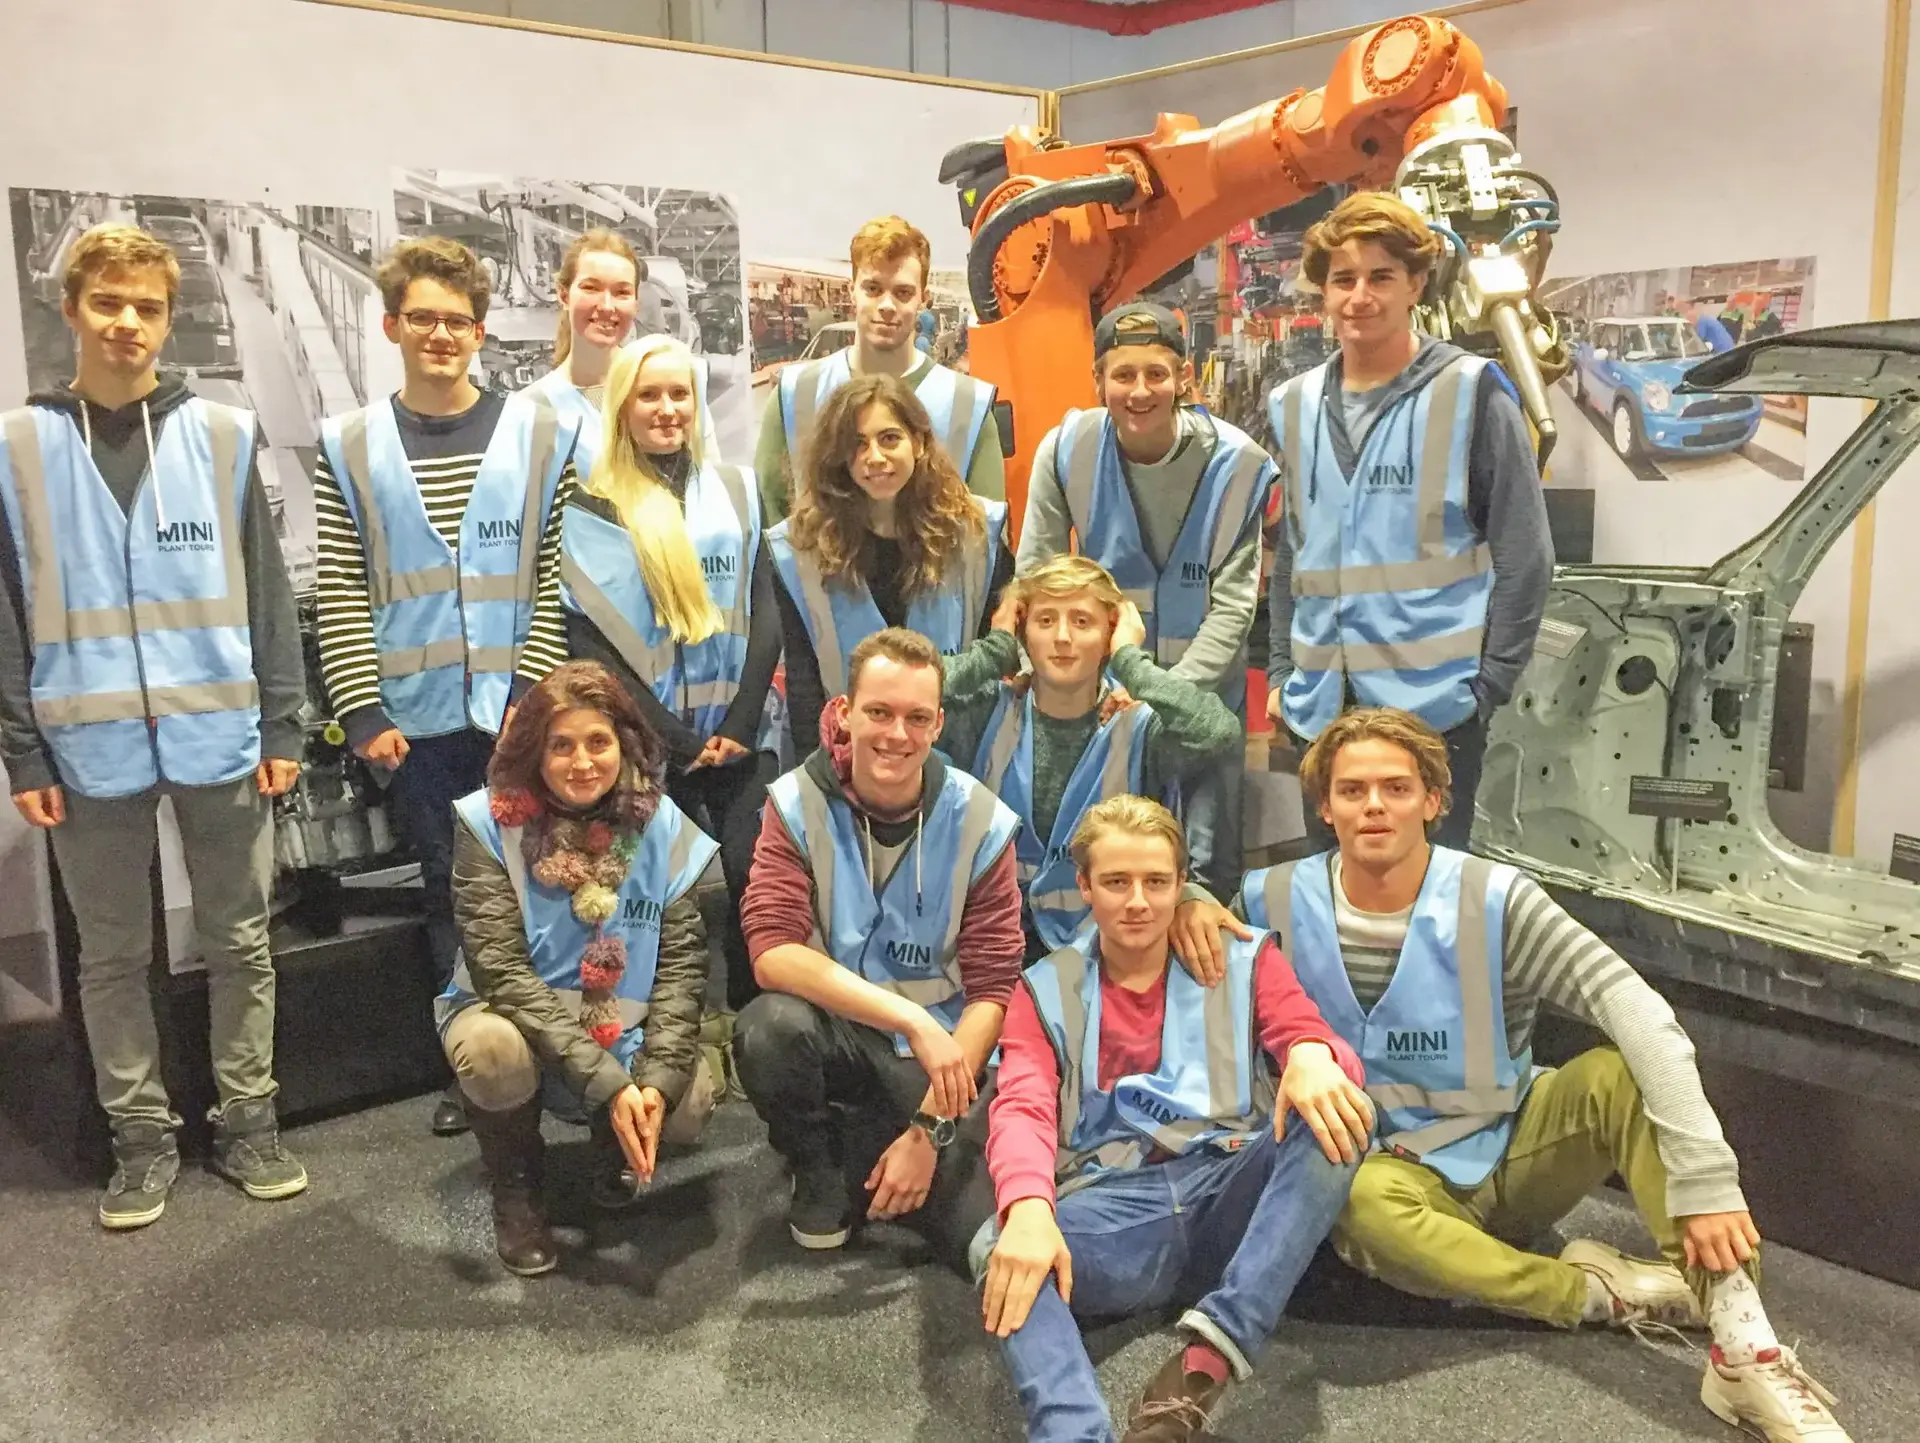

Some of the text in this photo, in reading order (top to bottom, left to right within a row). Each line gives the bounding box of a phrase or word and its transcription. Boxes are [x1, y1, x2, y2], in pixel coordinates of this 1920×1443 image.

[156, 521, 213, 542] MINI
[478, 519, 520, 539] MIN
[189, 544, 214, 552] TOURS
[623, 899, 661, 921] MIN
[886, 940, 930, 964] MIN
[1387, 1031, 1448, 1051] MINI
